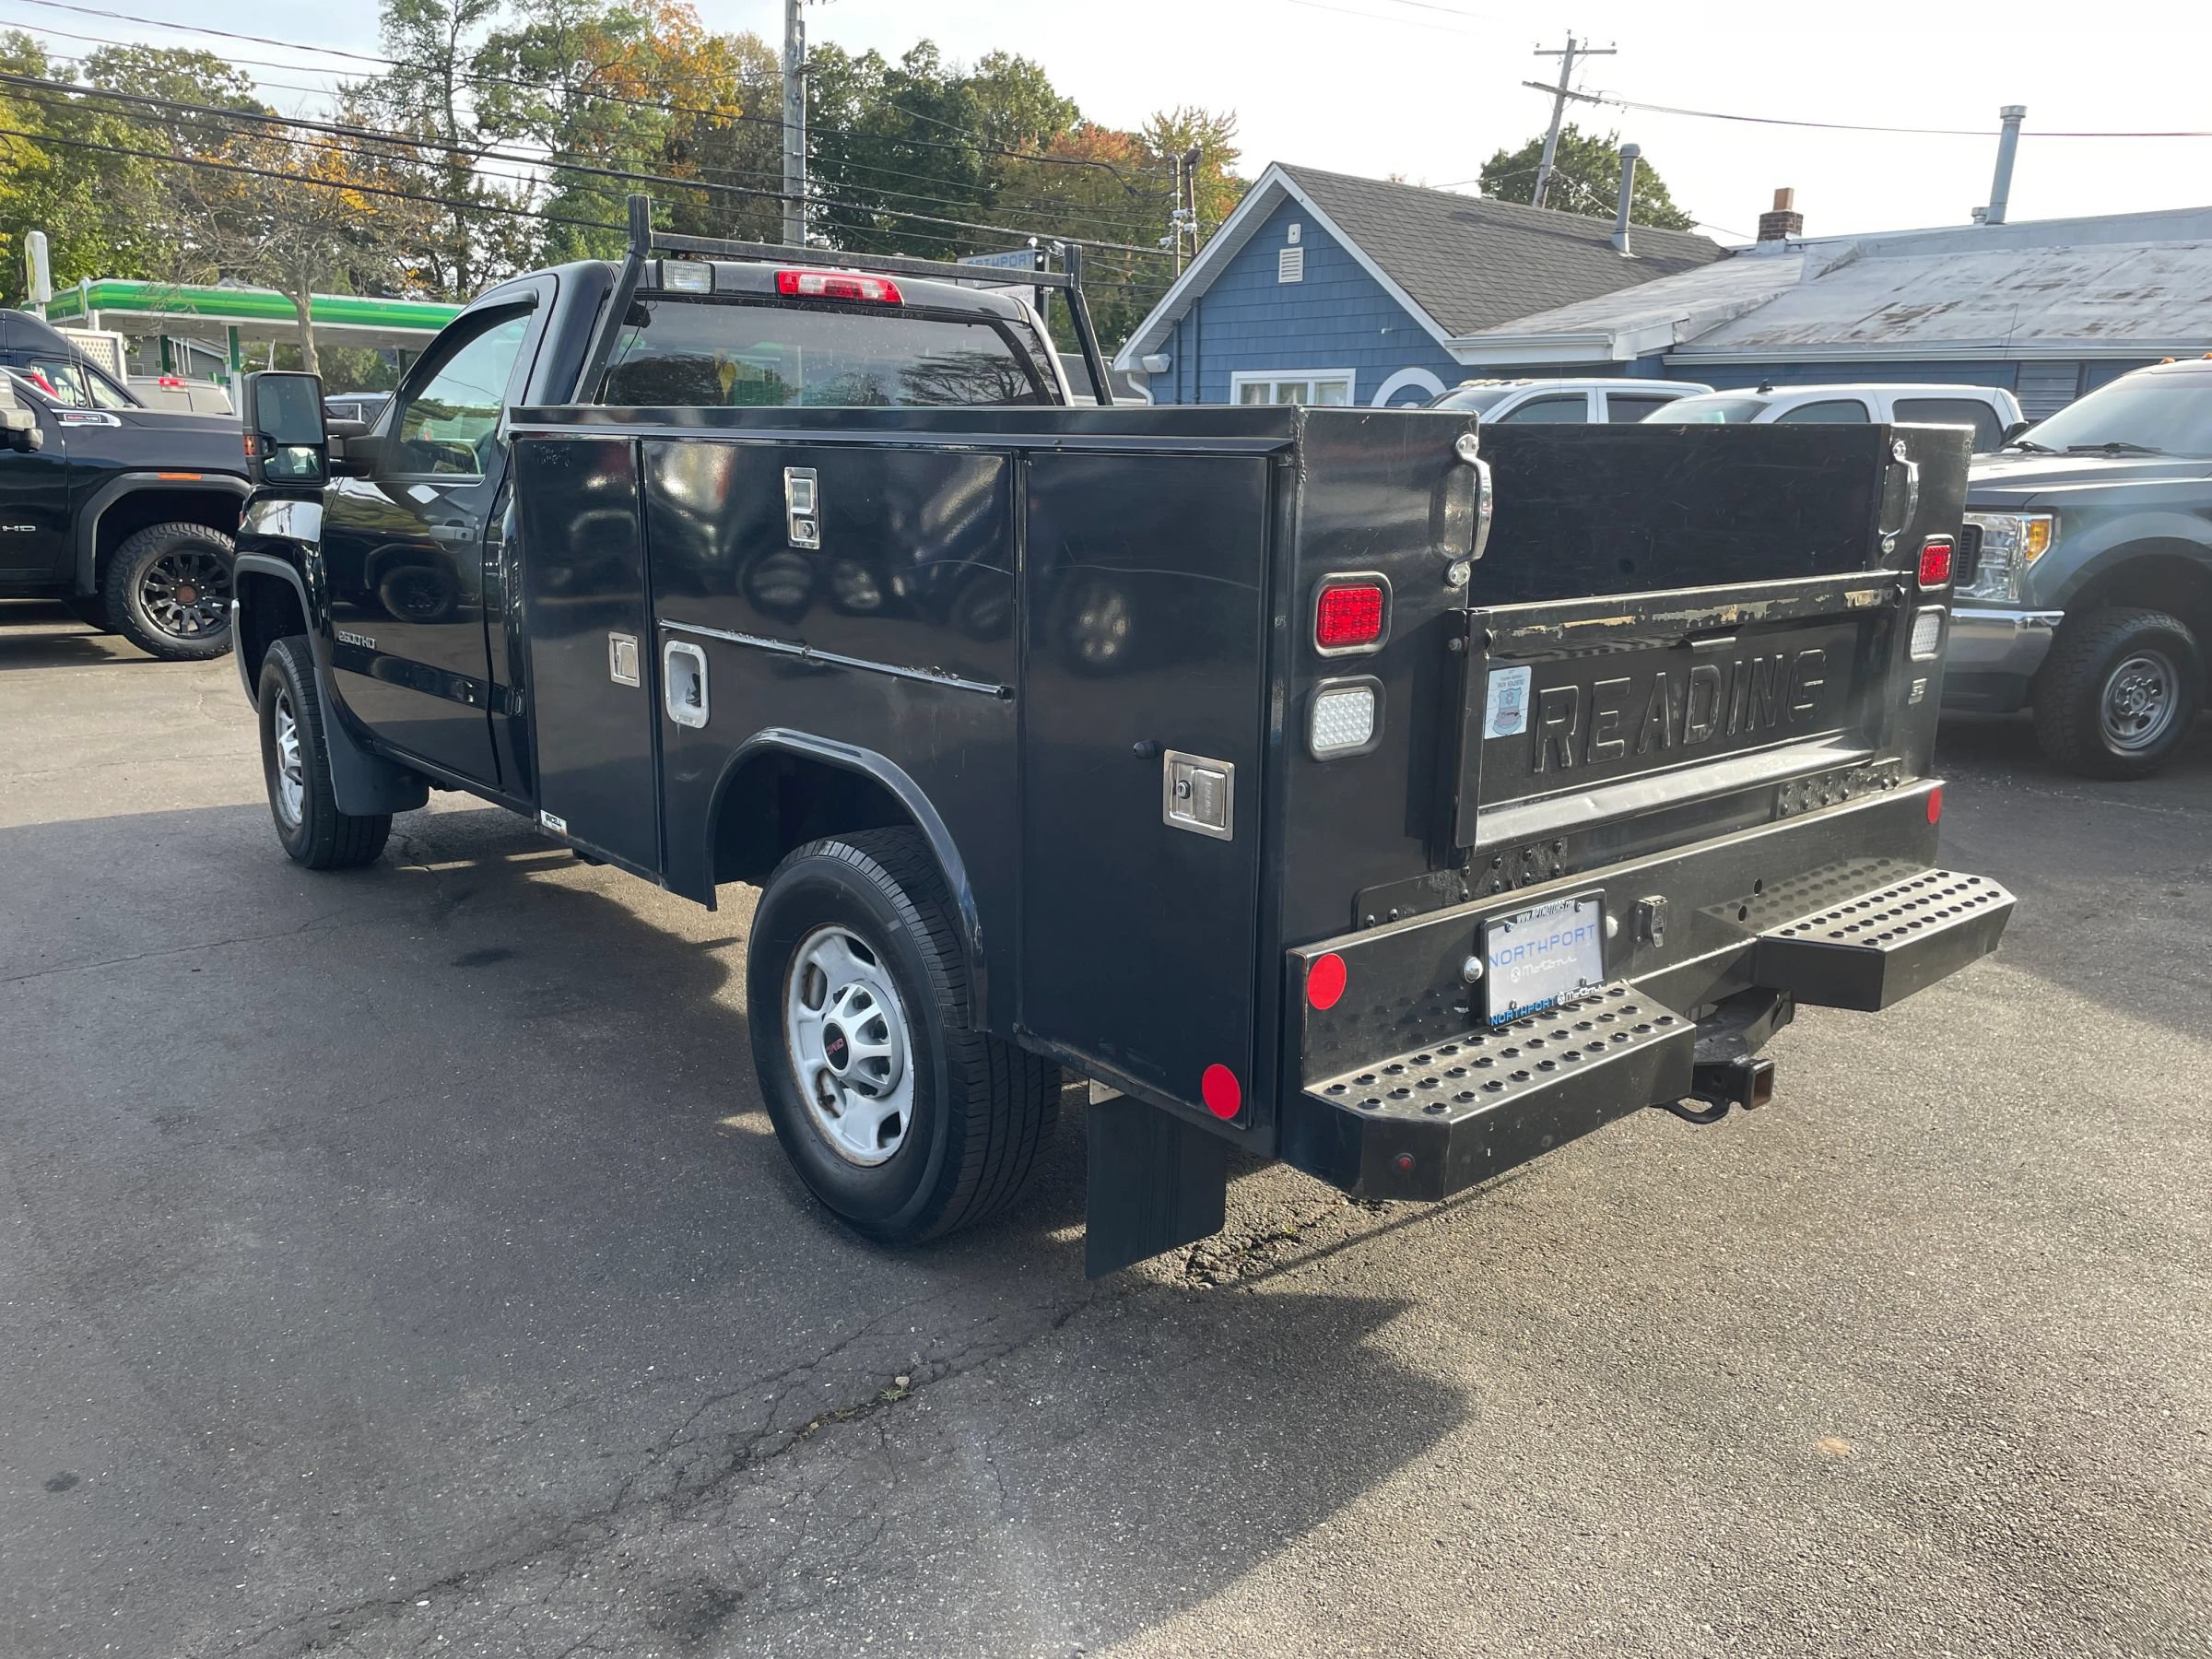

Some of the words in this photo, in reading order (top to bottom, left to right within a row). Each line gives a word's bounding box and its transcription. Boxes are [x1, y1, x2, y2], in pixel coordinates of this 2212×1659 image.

[361, 636, 375, 650] HD
[1534, 649, 1827, 773] READING
[1489, 924, 1595, 968] NORTHPORT
[1490, 997, 1556, 1026] NORTHPORT
